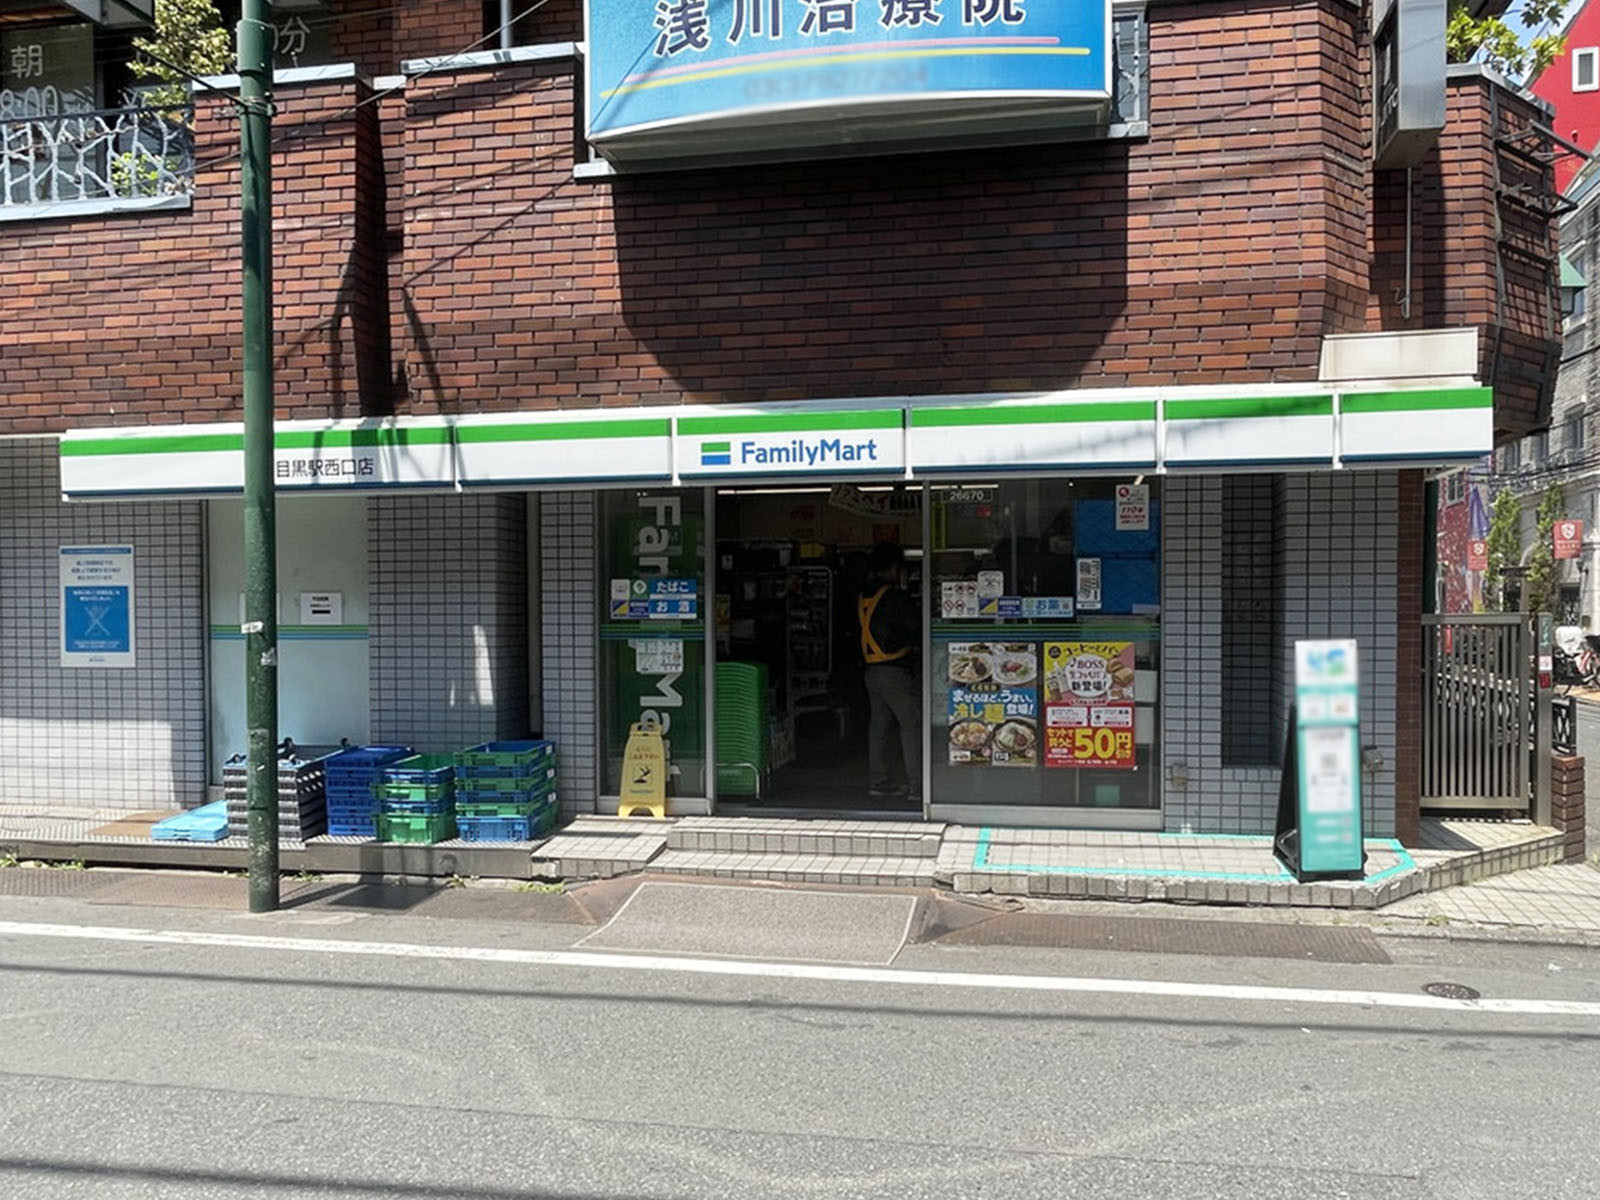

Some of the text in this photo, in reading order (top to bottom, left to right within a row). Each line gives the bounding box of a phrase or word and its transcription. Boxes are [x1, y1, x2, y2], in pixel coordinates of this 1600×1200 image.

[10, 45, 43, 79] 朝
[741, 438, 877, 466] FamilyMart
[276, 458, 374, 478] 目黒駅西口店
[656, 581, 690, 593] たばこ
